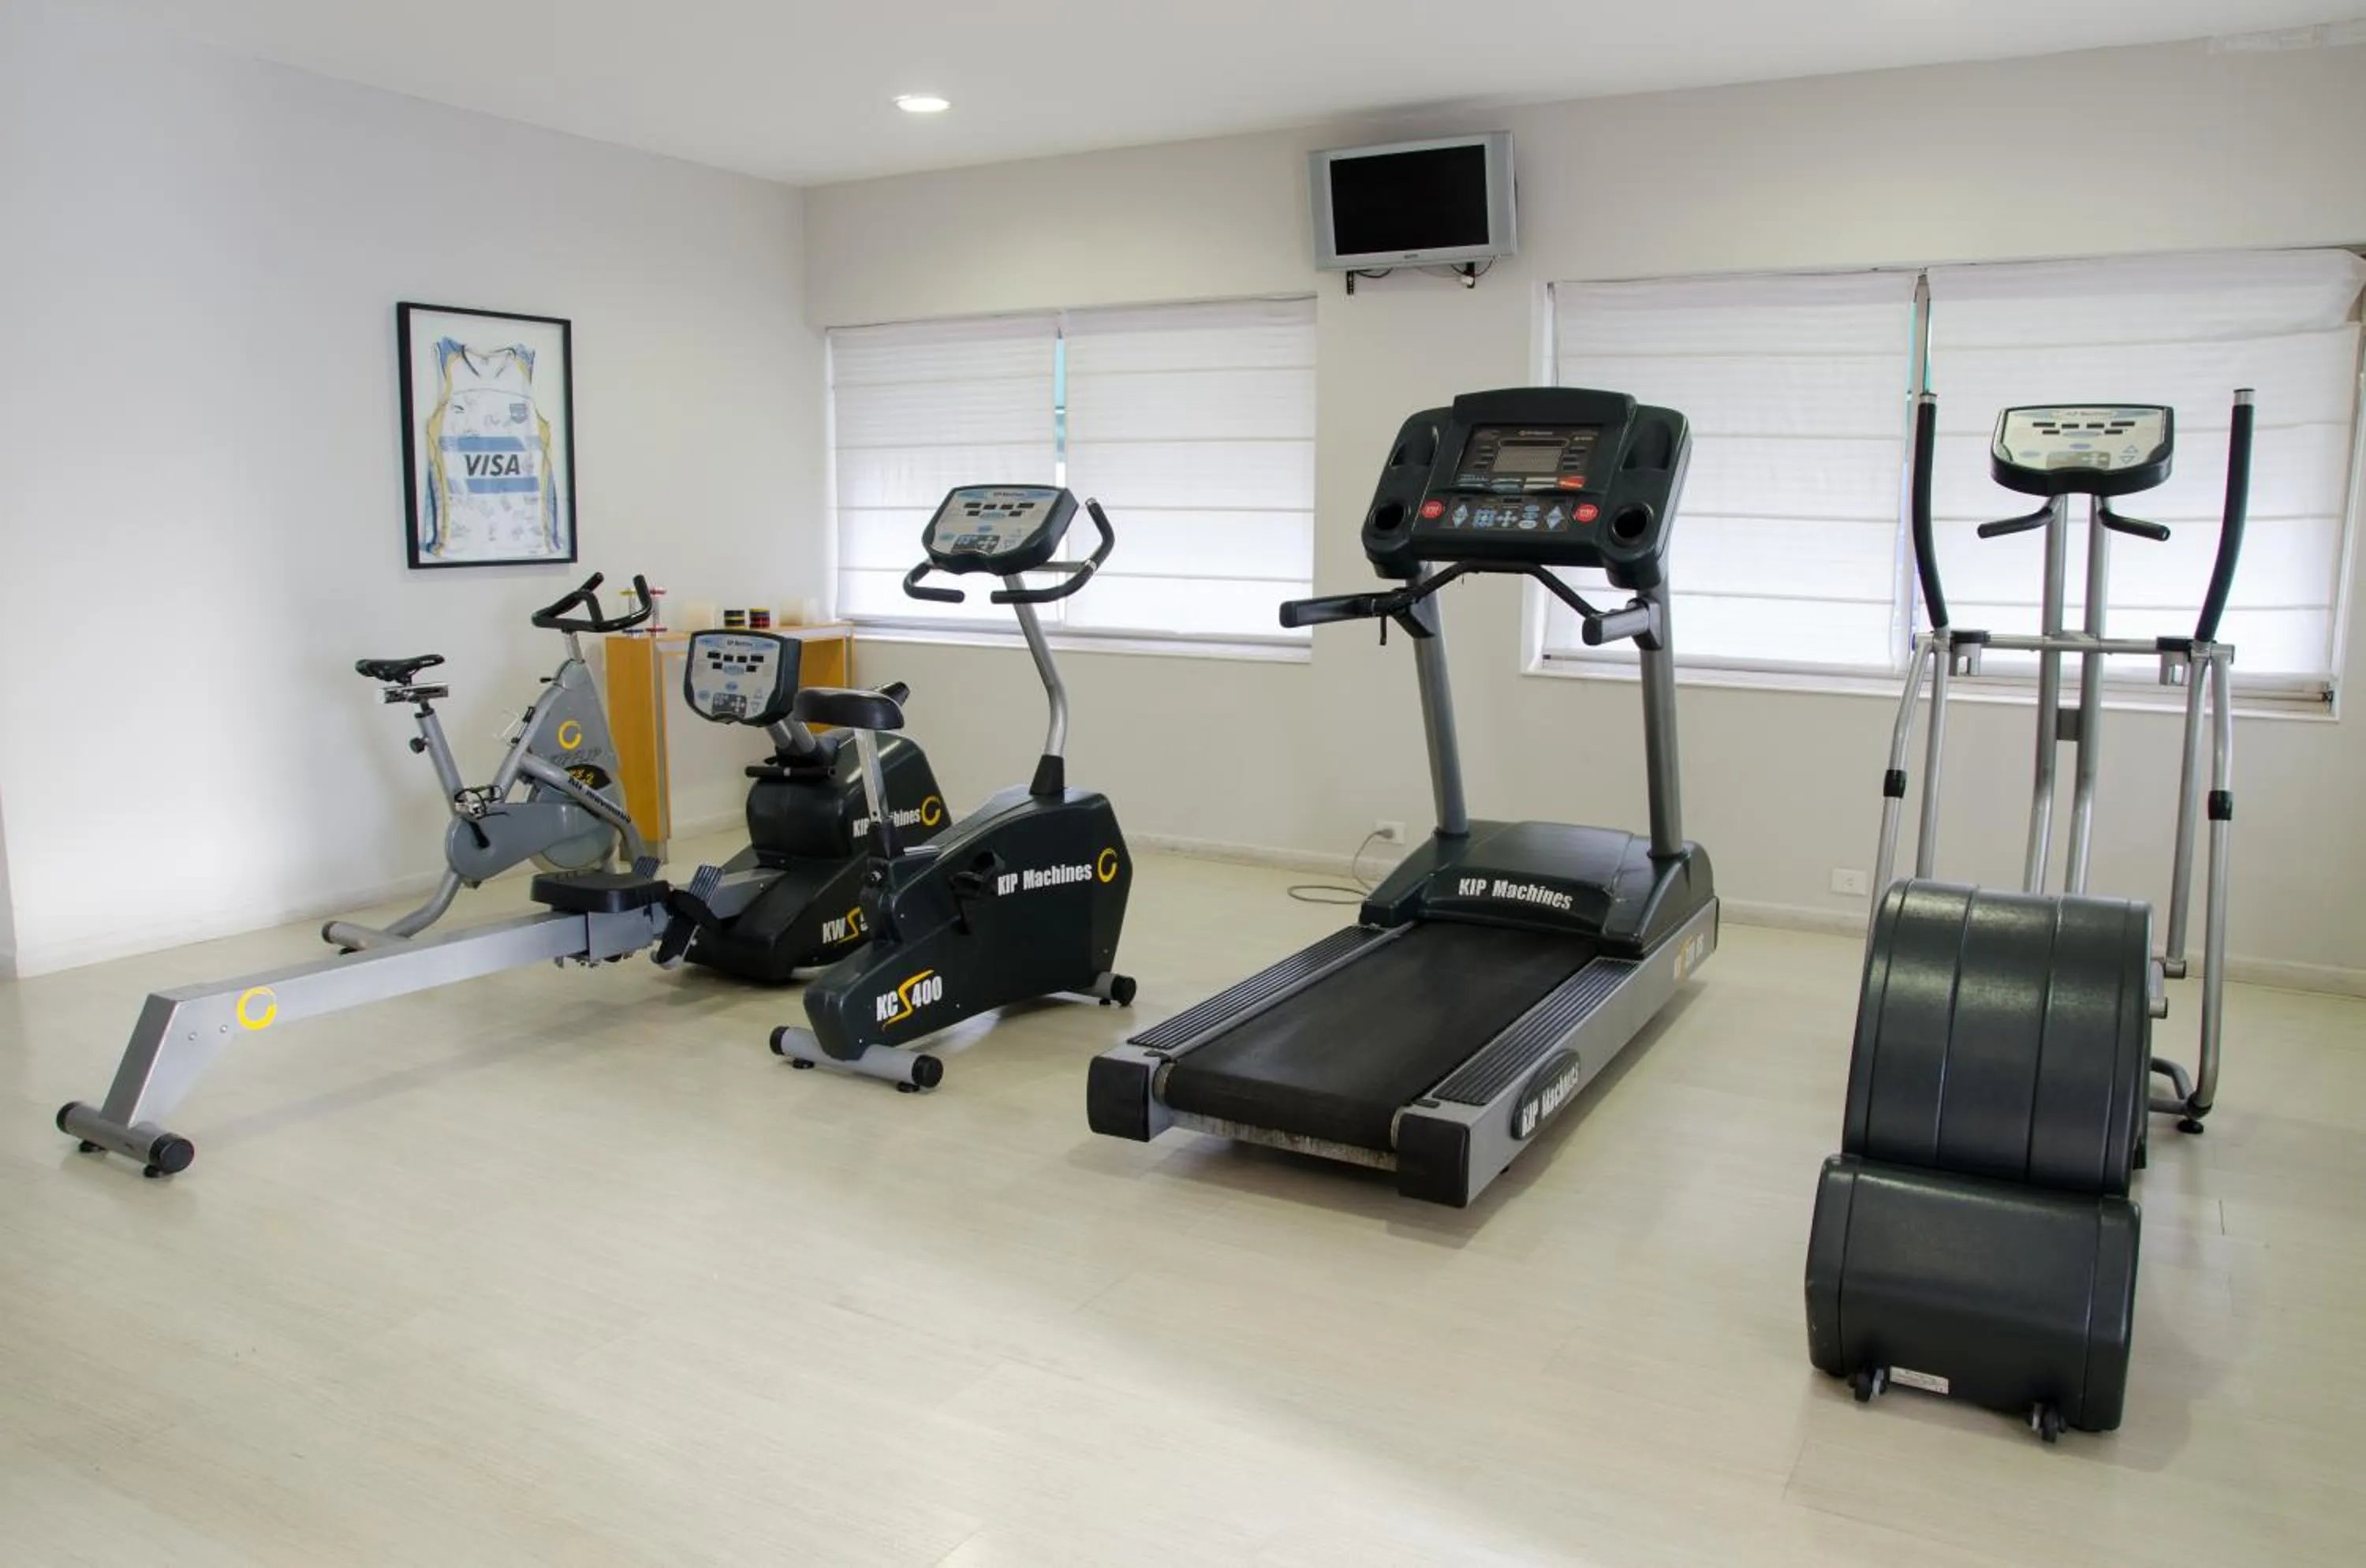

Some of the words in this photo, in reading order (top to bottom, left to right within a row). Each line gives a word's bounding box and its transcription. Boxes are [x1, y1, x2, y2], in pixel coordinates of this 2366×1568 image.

[465, 454, 521, 476] VISA
[998, 873, 1018, 896] KIP
[1023, 864, 1093, 890] Machines
[1459, 878, 1487, 896] KIP
[1491, 879, 1573, 909] Machines
